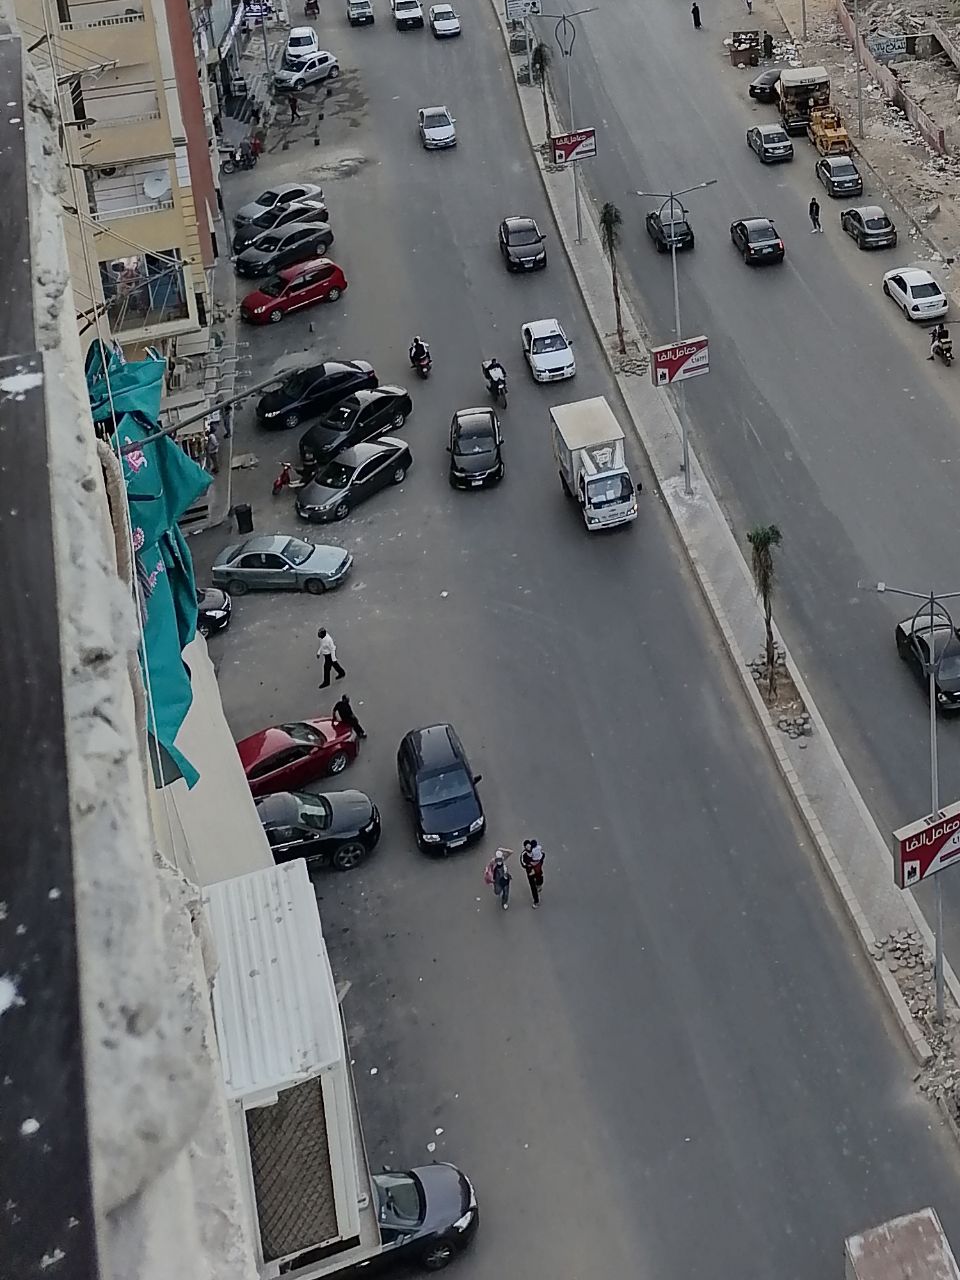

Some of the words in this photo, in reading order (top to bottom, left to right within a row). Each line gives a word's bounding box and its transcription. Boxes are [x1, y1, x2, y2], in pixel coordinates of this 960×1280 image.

[672, 346, 697, 360] معامل
[906, 832, 926, 852] الفا
[926, 820, 960, 845] معامل
